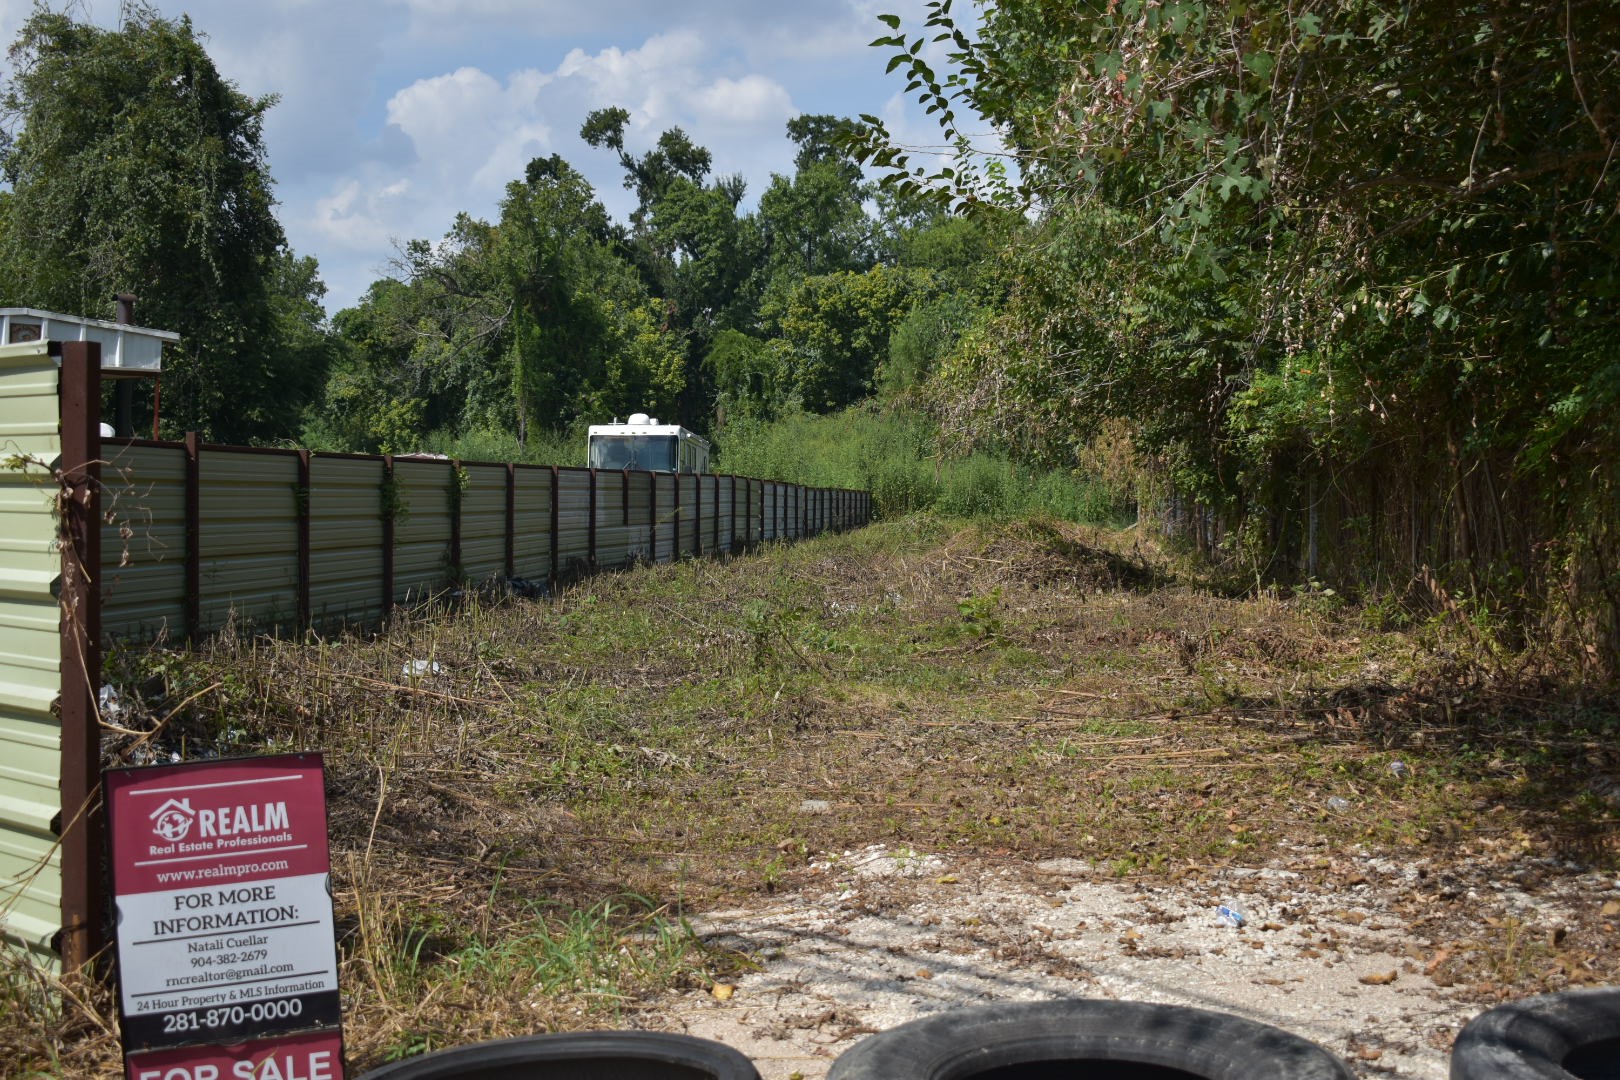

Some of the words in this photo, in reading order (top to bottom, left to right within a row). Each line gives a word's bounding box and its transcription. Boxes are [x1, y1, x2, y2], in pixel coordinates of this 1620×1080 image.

[199, 801, 290, 838] REALM
[149, 845, 176, 856] Real
[178, 839, 214, 853] Estate
[217, 832, 293, 848] Professionals
[156, 859, 289, 883] www.realmpro.com
[174, 889, 213, 910] FOR
[218, 885, 276, 906] MORE
[153, 905, 299, 935] INFORMATION:
[187, 940, 224, 953] Natali
[227, 935, 269, 948] Cuellar
[190, 949, 268, 968] 904-382-2679
[165, 962, 294, 987] rncrealtor@gmail.com
[137, 1002, 150, 1012] 24
[152, 999, 178, 1010] Hour
[181, 993, 227, 1007] Property
[229, 990, 238, 1000] &
[239, 986, 263, 999] MLS
[264, 979, 325, 996] Information
[163, 998, 303, 1033] 281-870-0000
[232, 1050, 332, 1080] SALE
